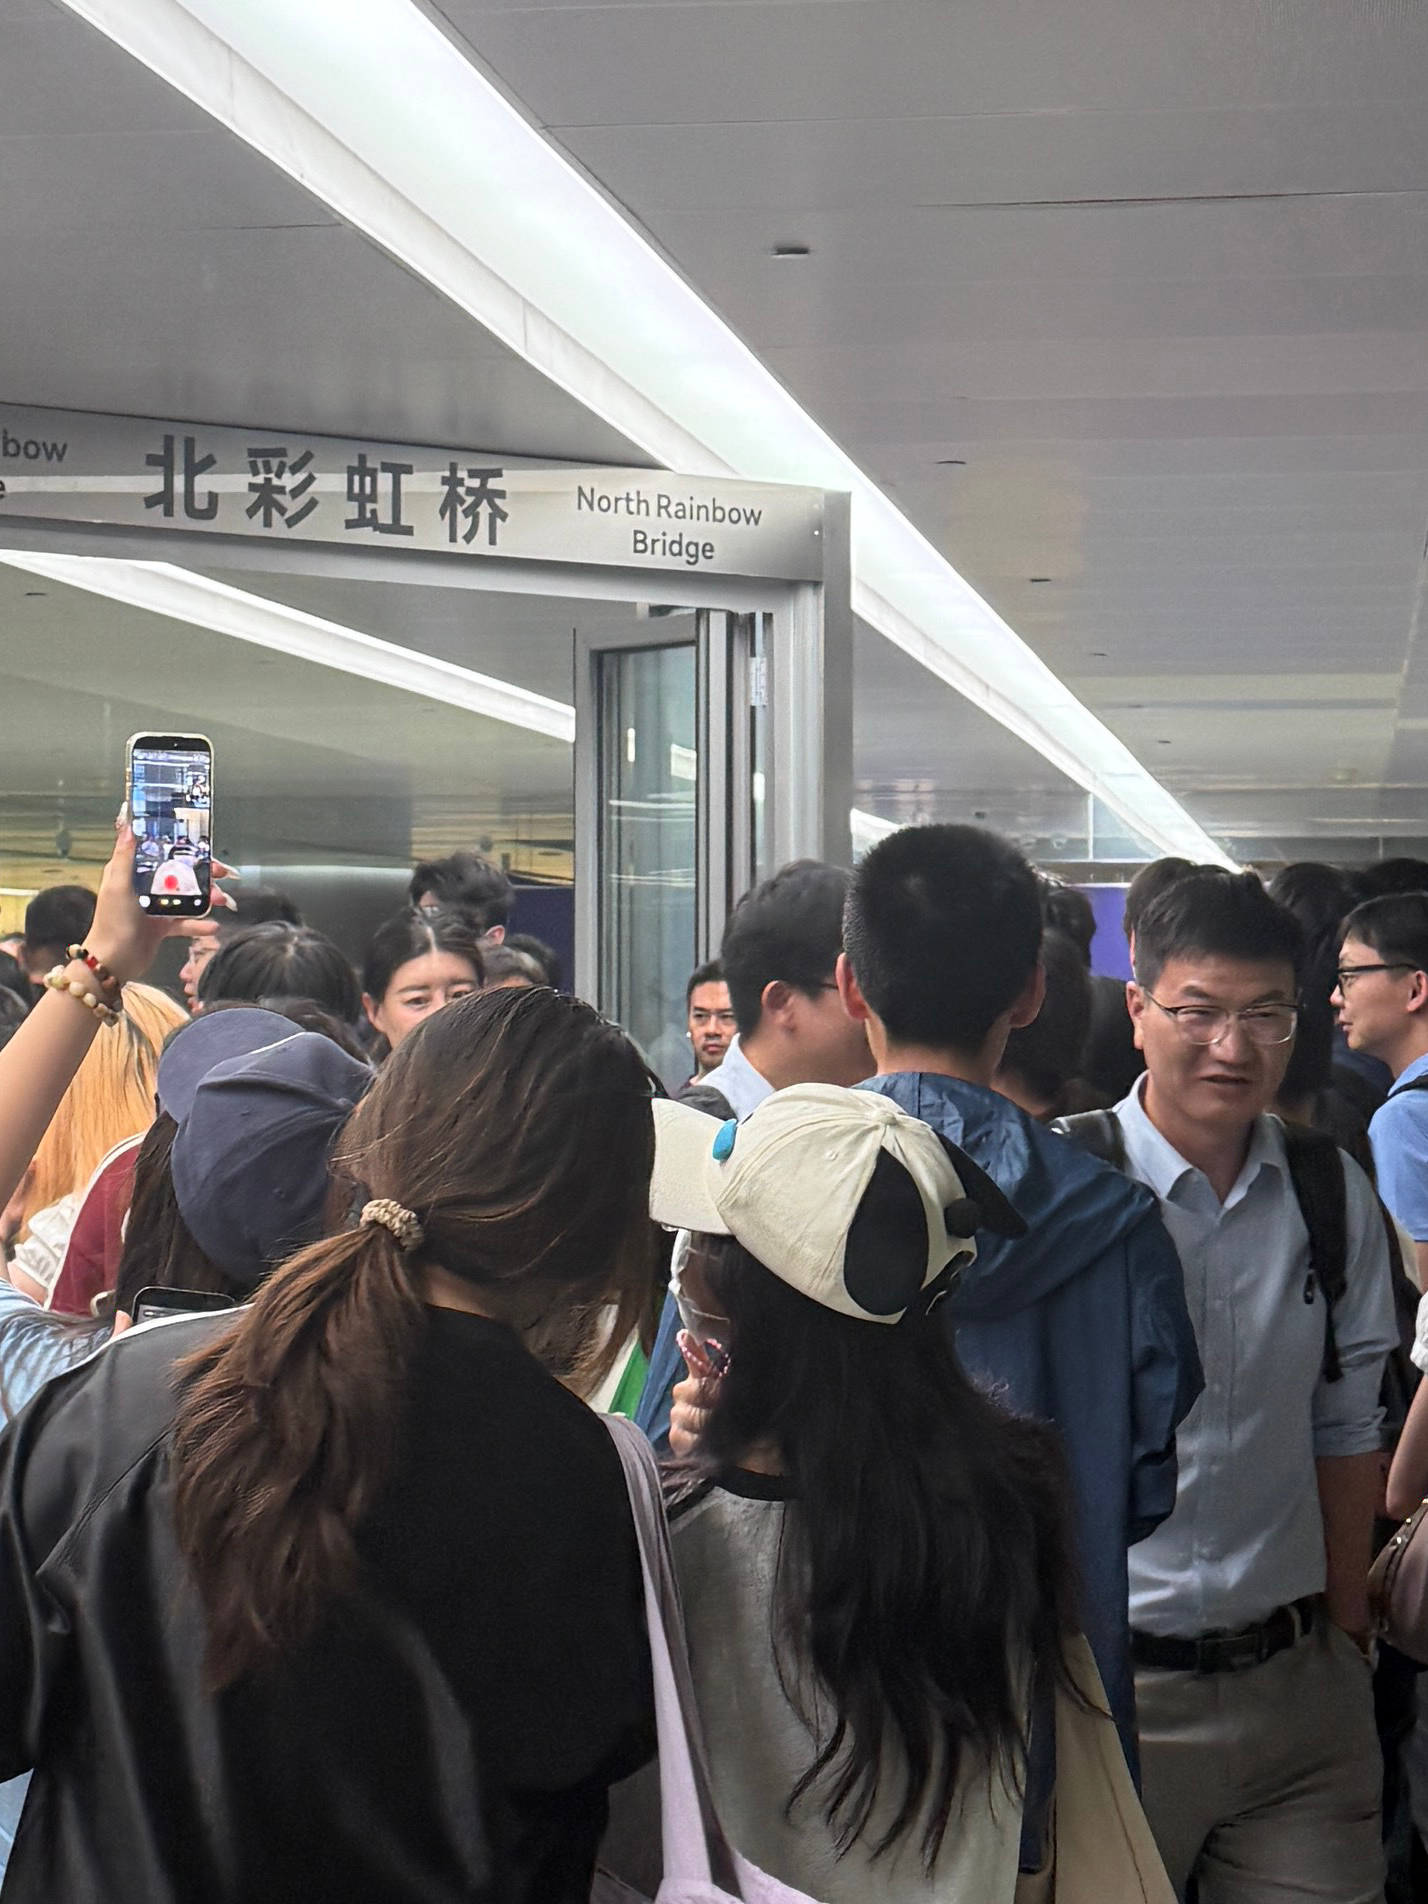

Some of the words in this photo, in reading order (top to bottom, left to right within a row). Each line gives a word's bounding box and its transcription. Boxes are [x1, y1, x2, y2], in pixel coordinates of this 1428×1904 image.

[143, 434, 509, 546] 北彩虹桥
[577, 485, 650, 517] North
[657, 493, 762, 526] Rainbow
[633, 529, 715, 566] Bridge
